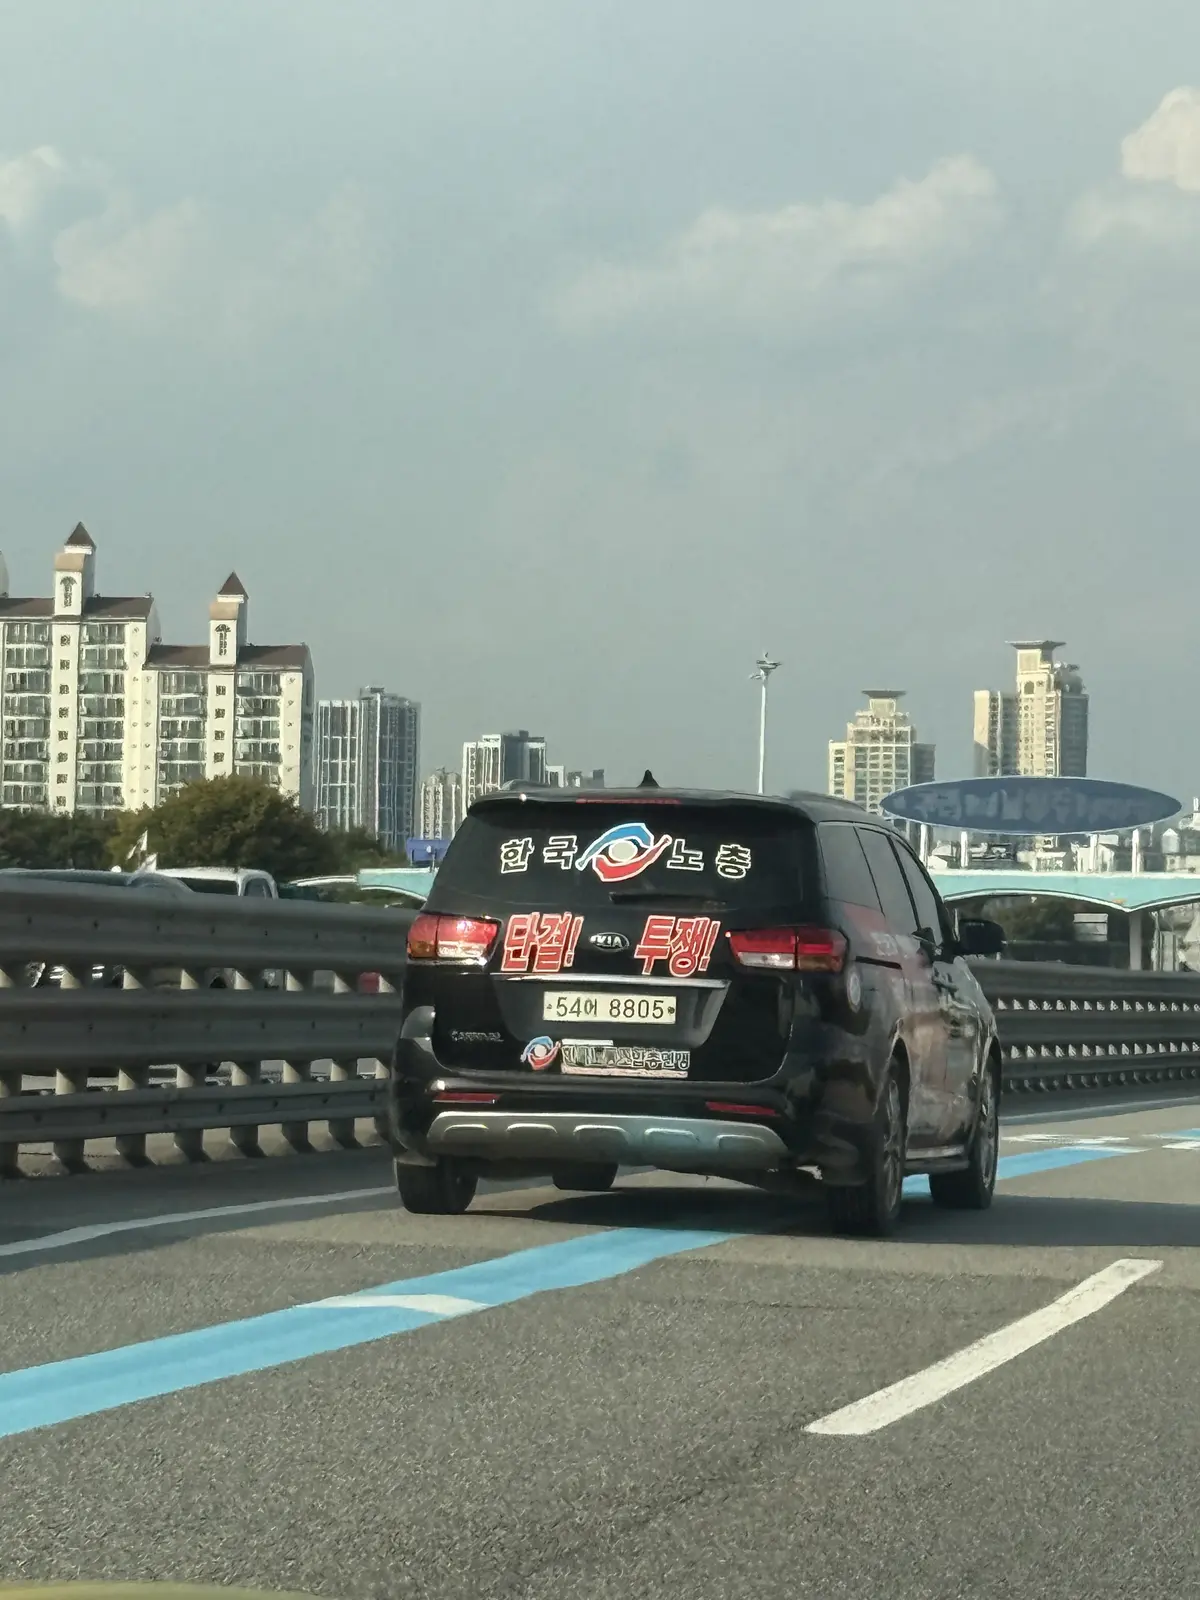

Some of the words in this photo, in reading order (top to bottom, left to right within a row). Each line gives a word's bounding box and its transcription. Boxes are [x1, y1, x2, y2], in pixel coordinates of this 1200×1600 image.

[500, 911, 585, 973] 단결!
[634, 915, 721, 978] 투쟁!
[555, 995, 598, 1019] 54어
[609, 998, 665, 1020] 8805
